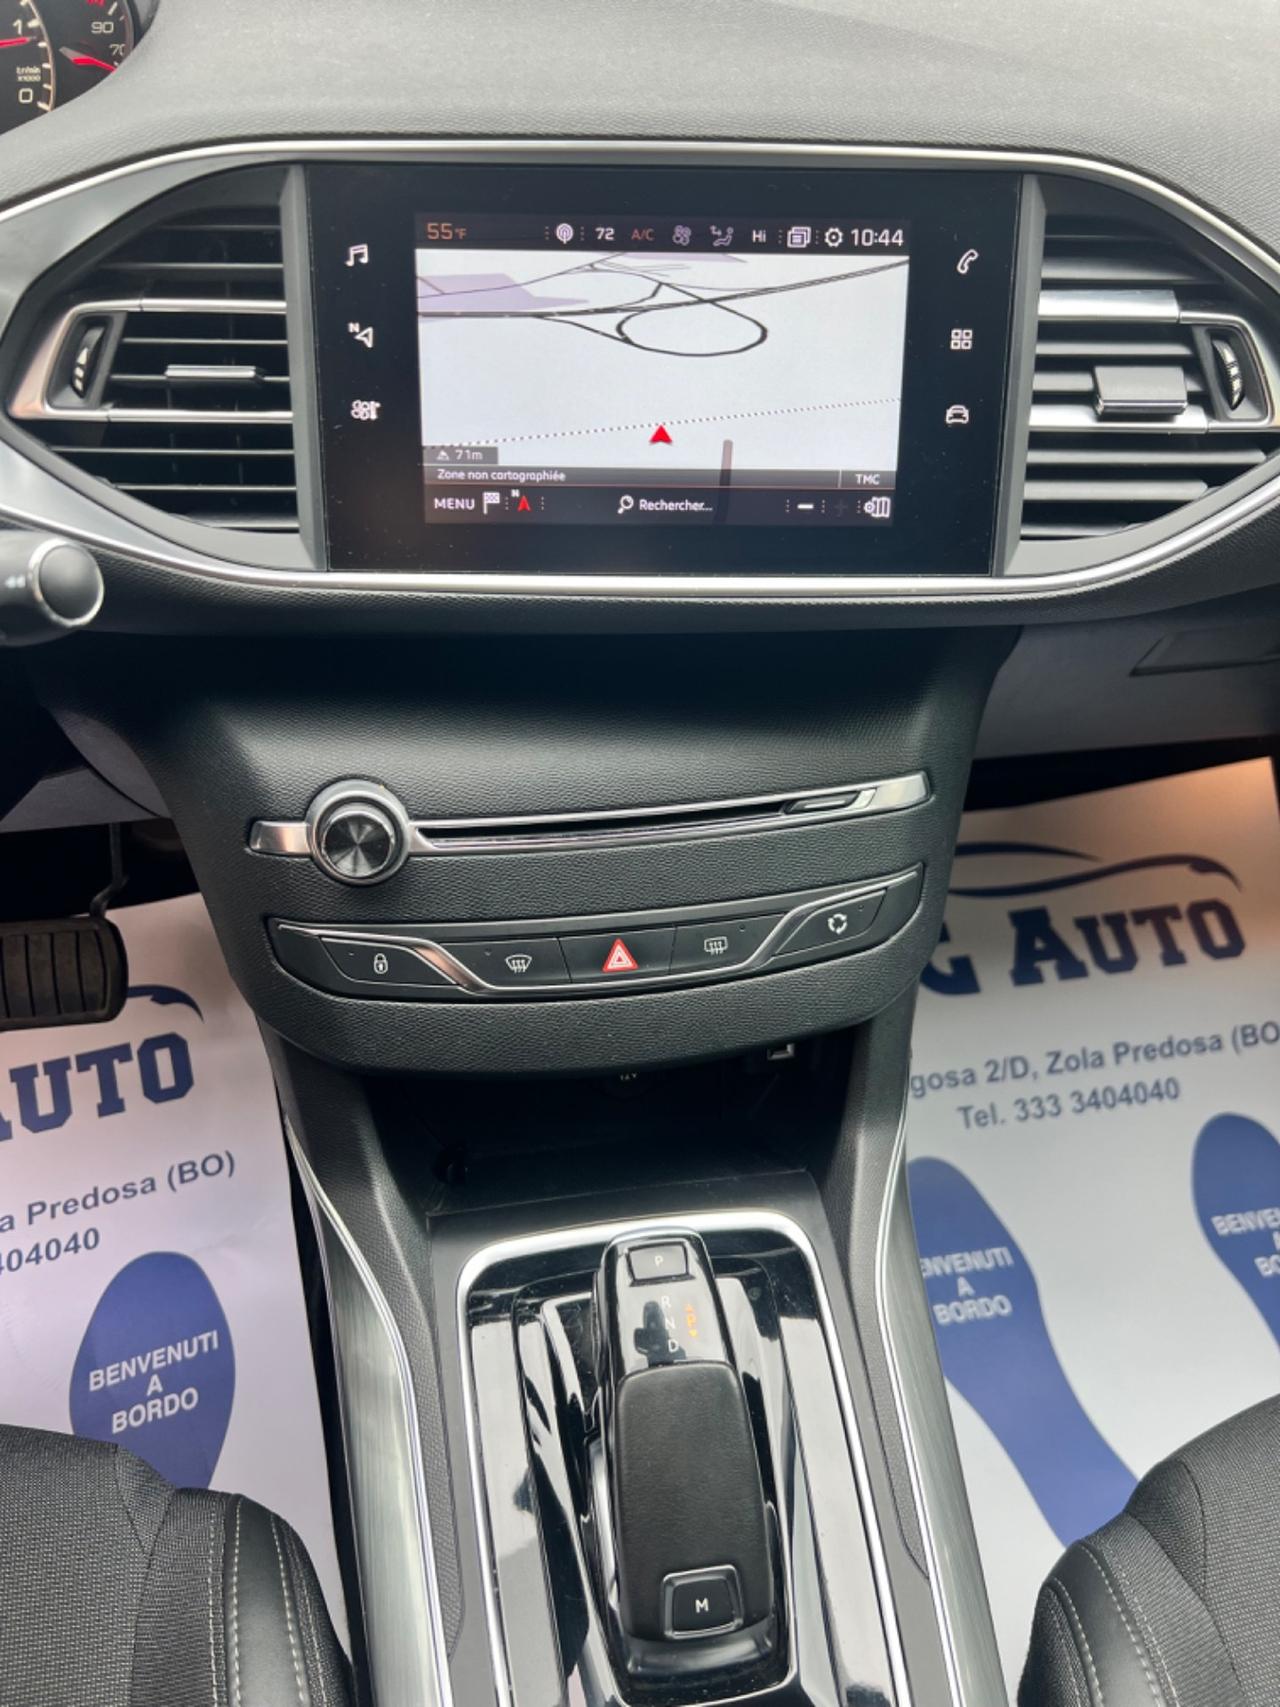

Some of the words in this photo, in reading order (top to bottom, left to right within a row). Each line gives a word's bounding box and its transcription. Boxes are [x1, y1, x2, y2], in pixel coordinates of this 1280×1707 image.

[13, 19, 23, 35] 1
[91, 21, 114, 34] 90
[18, 88, 33, 104] 0
[595, 227, 614, 241] 72
[631, 228, 654, 241] A/C
[752, 230, 767, 243] Hi
[850, 229, 904, 246] 10:44
[437, 469, 465, 480] Zone
[468, 472, 489, 480] non
[490, 470, 566, 483] cartographiée
[855, 473, 880, 485] TMC
[434, 498, 475, 510] MENU
[1008, 898, 1246, 987] AUTO
[984, 1055, 1039, 1084] 2/D,
[1046, 1047, 1104, 1075] Zola
[1114, 1031, 1223, 1066] Predosa
[0, 1032, 194, 1142] UTO
[957, 1103, 1006, 1129] Tel.
[1014, 1094, 1062, 1123] 333
[1071, 1077, 1180, 1114] 3404040
[27, 1175, 157, 1226] Predosa
[167, 1150, 235, 1192] (BO)
[0, 1227, 100, 1276] 04040
[957, 1276, 975, 1297] A
[932, 1294, 1014, 1326] BORDO
[89, 1330, 219, 1392] BENVENUTI
[146, 1374, 163, 1397] A
[112, 1387, 199, 1434] BORDO
[695, 1597, 709, 1614] M
